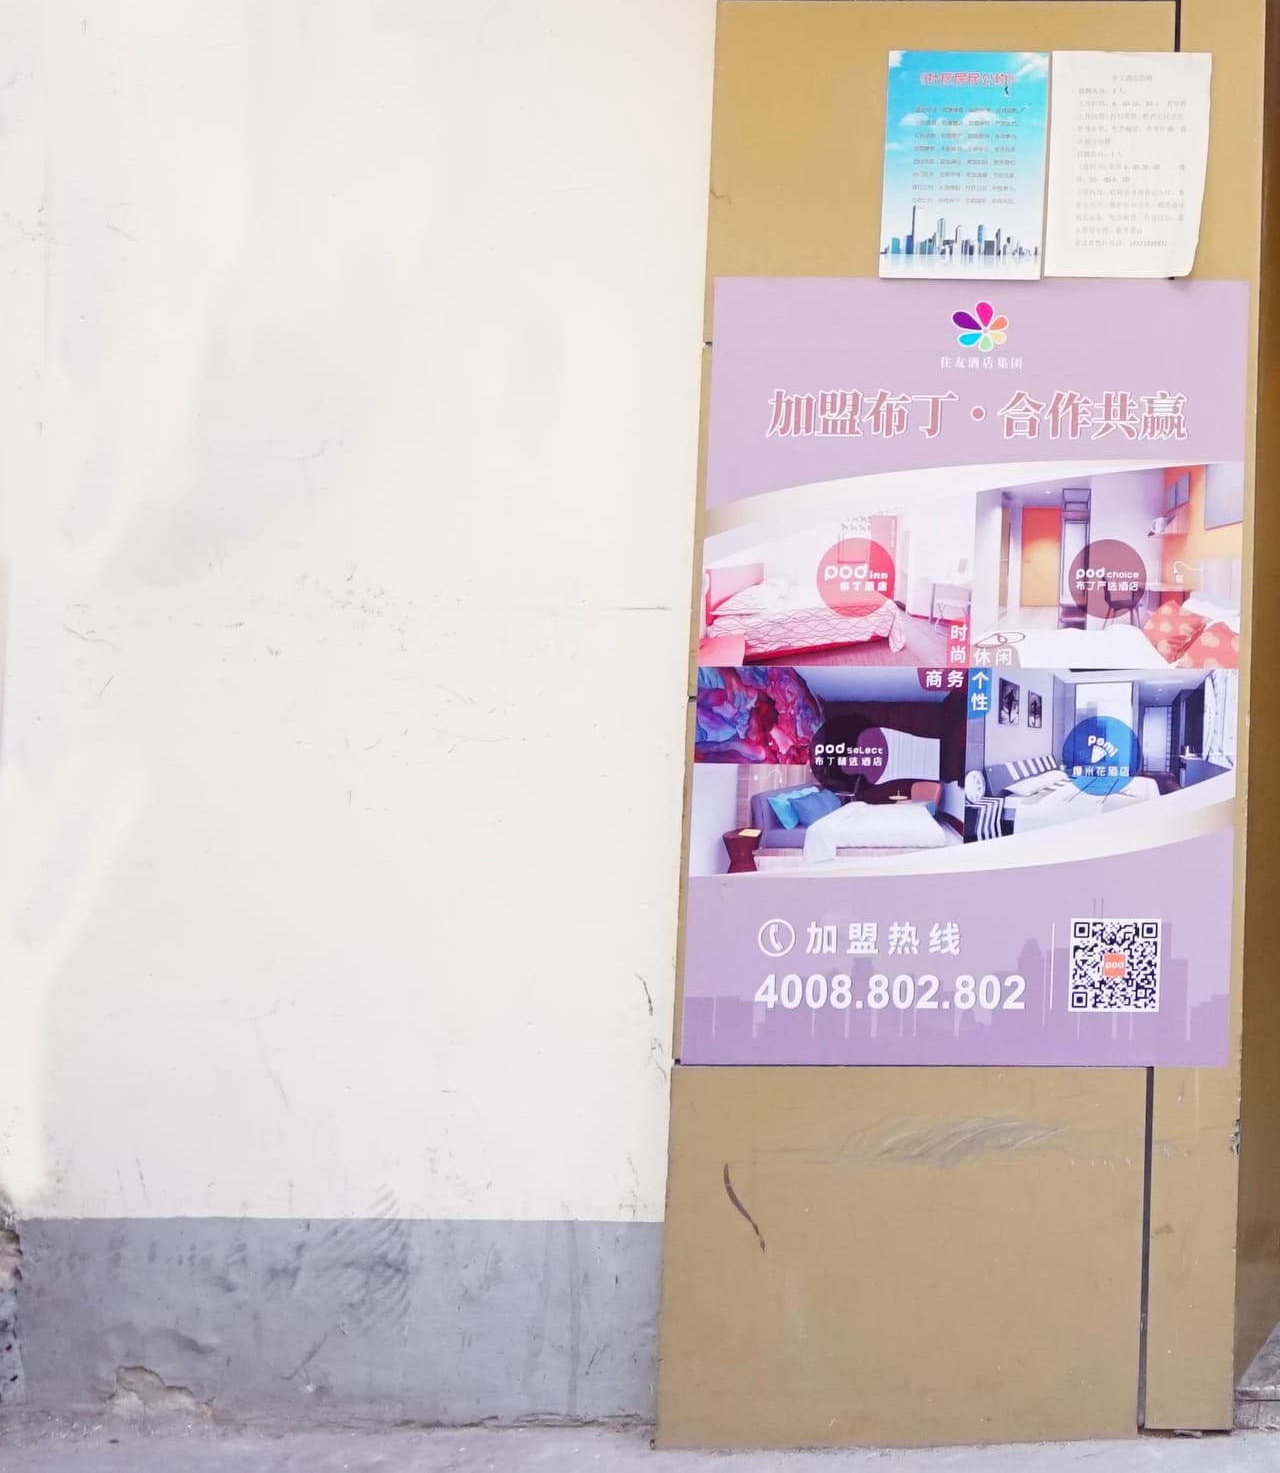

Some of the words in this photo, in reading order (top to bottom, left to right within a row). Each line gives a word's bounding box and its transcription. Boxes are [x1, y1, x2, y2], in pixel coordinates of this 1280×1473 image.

[940, 356, 1023, 370] 住友酒店集团
[824, 563, 868, 581] pod
[1076, 567, 1105, 580] pod
[1106, 571, 1140, 579] choice
[950, 624, 967, 663] 时尚
[974, 647, 1012, 665] 休闲
[925, 670, 964, 688] 商务
[970, 671, 989, 711] 个性
[814, 742, 845, 756] pod
[806, 921, 961, 955] 加盟热线
[754, 973, 1027, 1010] 4008.802.802
